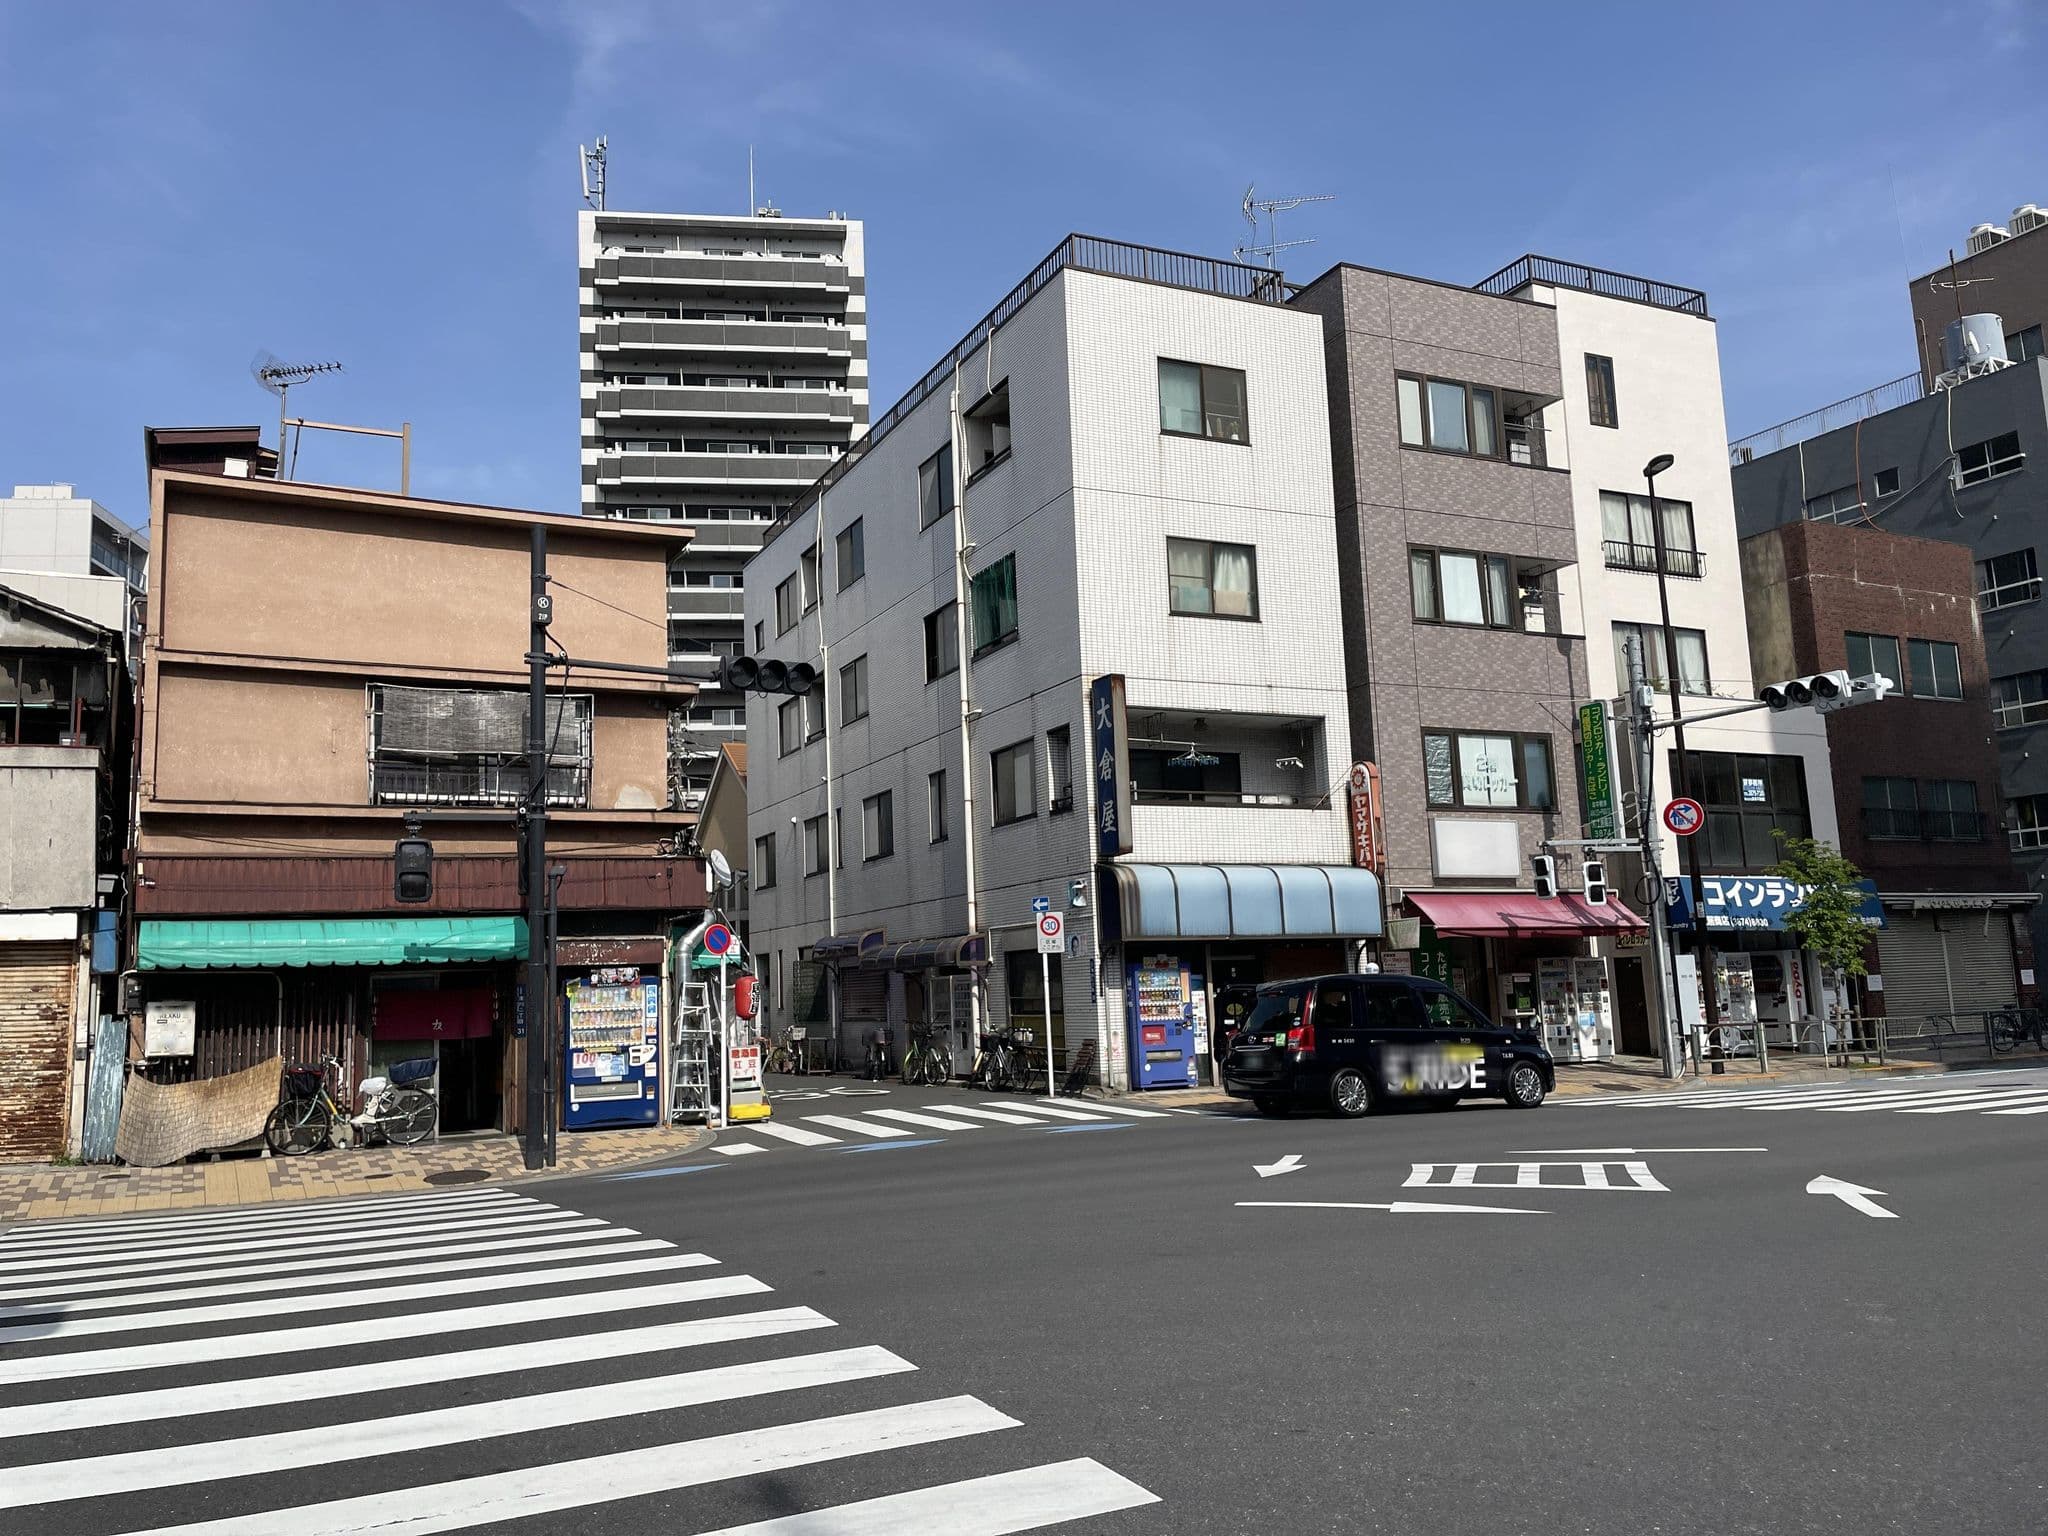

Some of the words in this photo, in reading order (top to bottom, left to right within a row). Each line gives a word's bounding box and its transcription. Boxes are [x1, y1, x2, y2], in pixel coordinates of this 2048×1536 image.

[1096, 697, 1117, 834] 大倉屋
[1044, 921, 1056, 931] 30
[575, 1053, 597, 1065] 100
